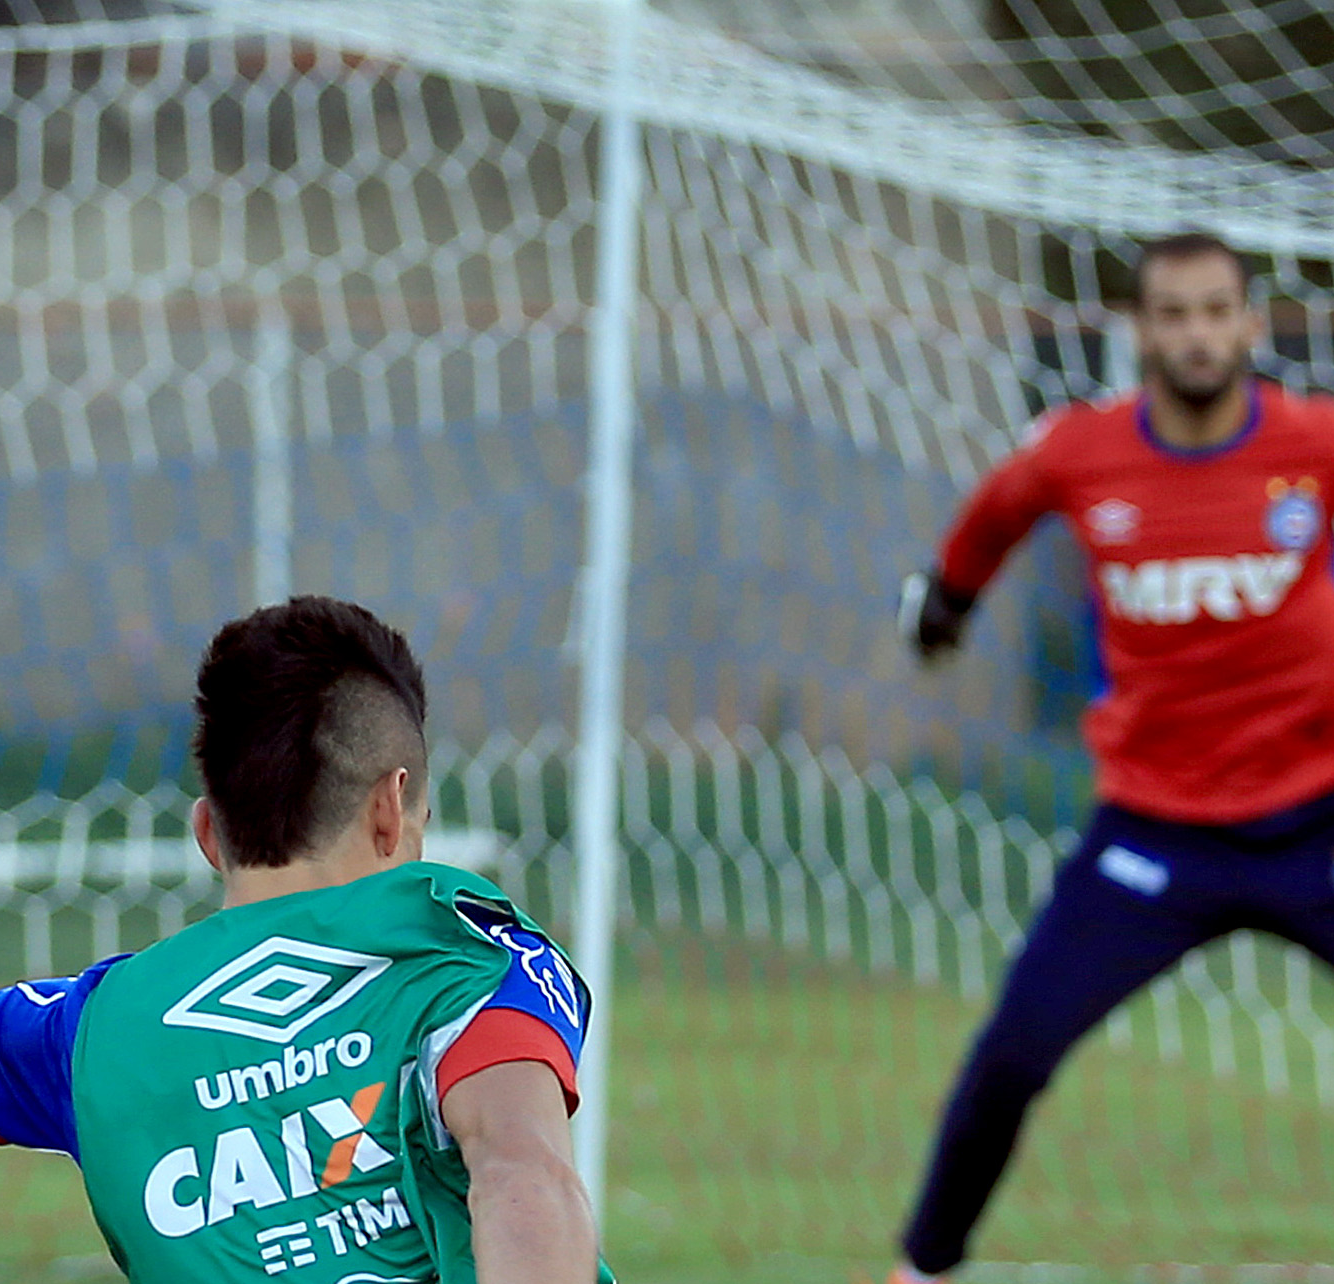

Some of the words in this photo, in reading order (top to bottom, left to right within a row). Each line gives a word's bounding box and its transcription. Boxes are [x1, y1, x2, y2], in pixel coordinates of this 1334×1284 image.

[1099, 551, 1307, 625] MRV
[194, 1031, 372, 1110] umbro
[144, 1081, 396, 1238] CAIX
[315, 1186, 411, 1256] TIM
